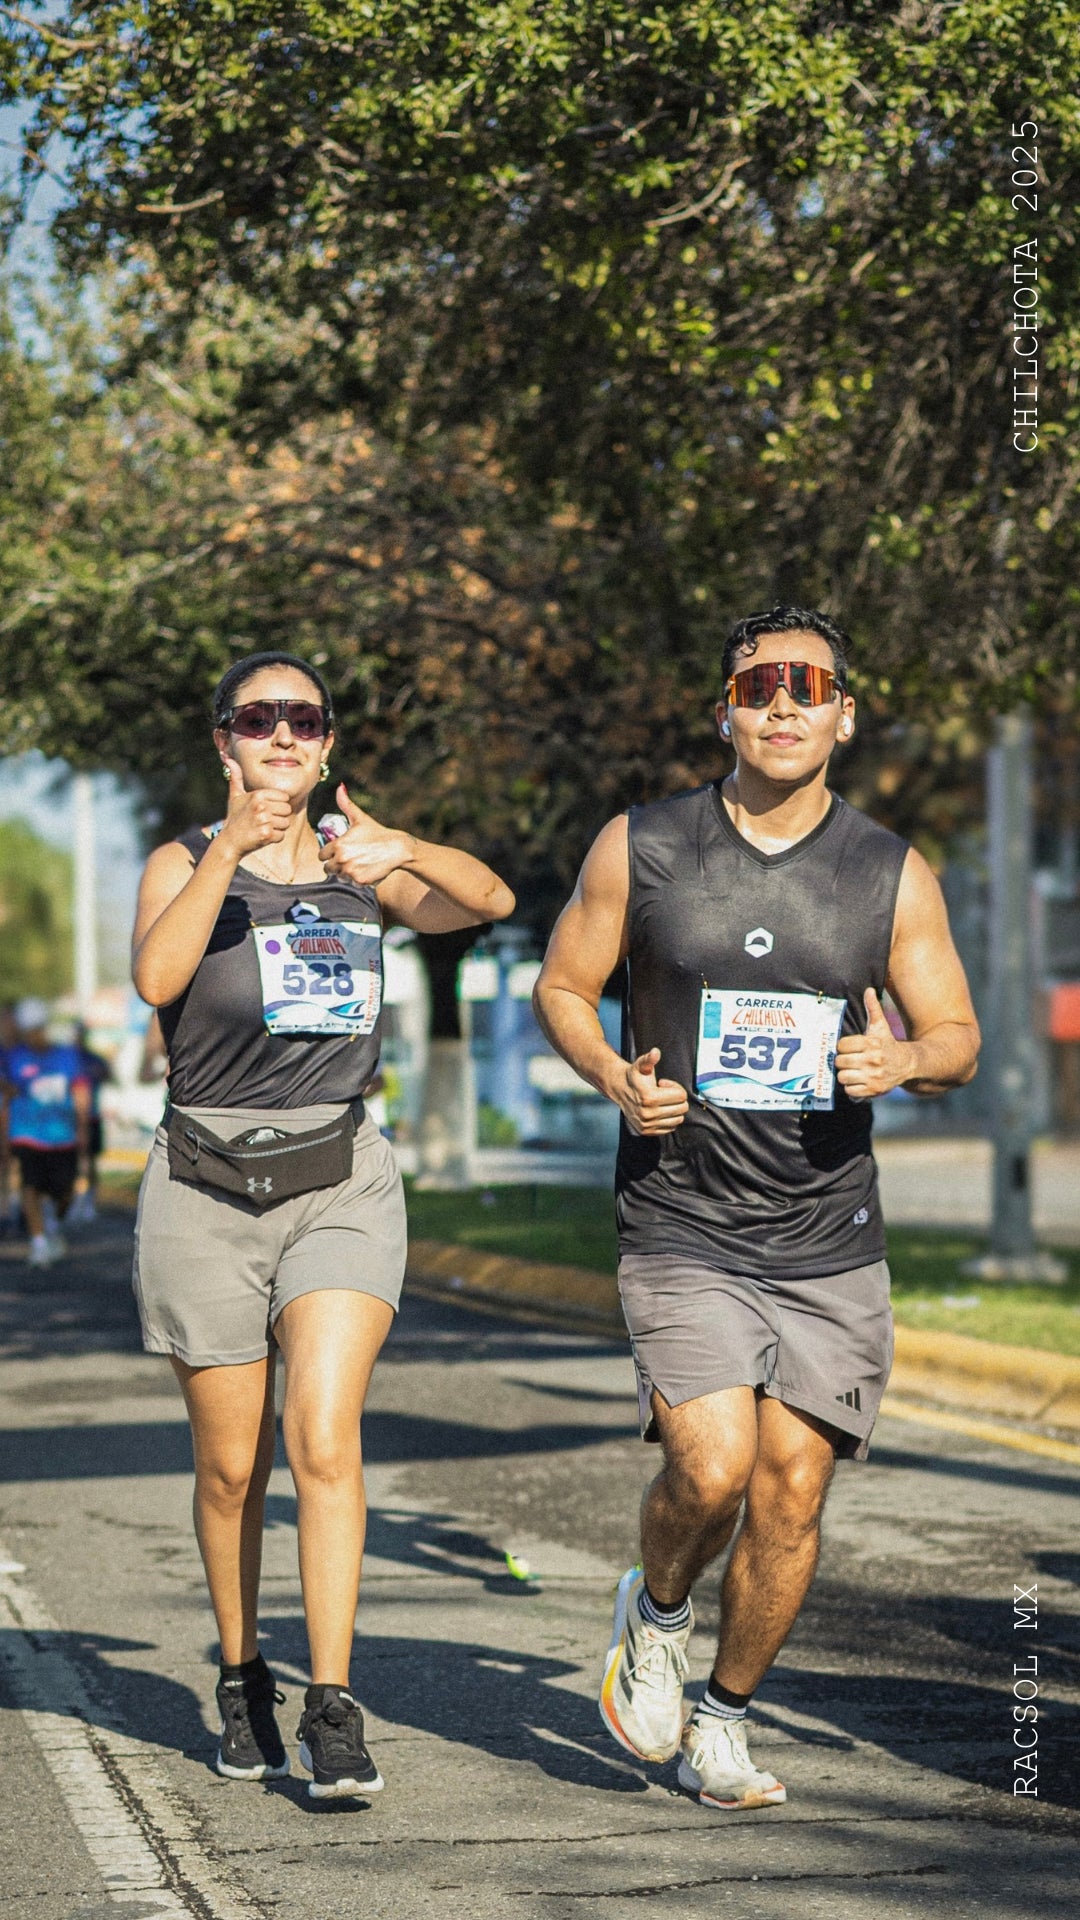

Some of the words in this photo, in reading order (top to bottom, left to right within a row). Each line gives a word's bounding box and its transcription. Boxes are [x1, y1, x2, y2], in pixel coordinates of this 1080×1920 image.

[283, 962, 354, 996] 528
[735, 997, 793, 1009] CARRERA
[719, 1034, 802, 1072] 537
